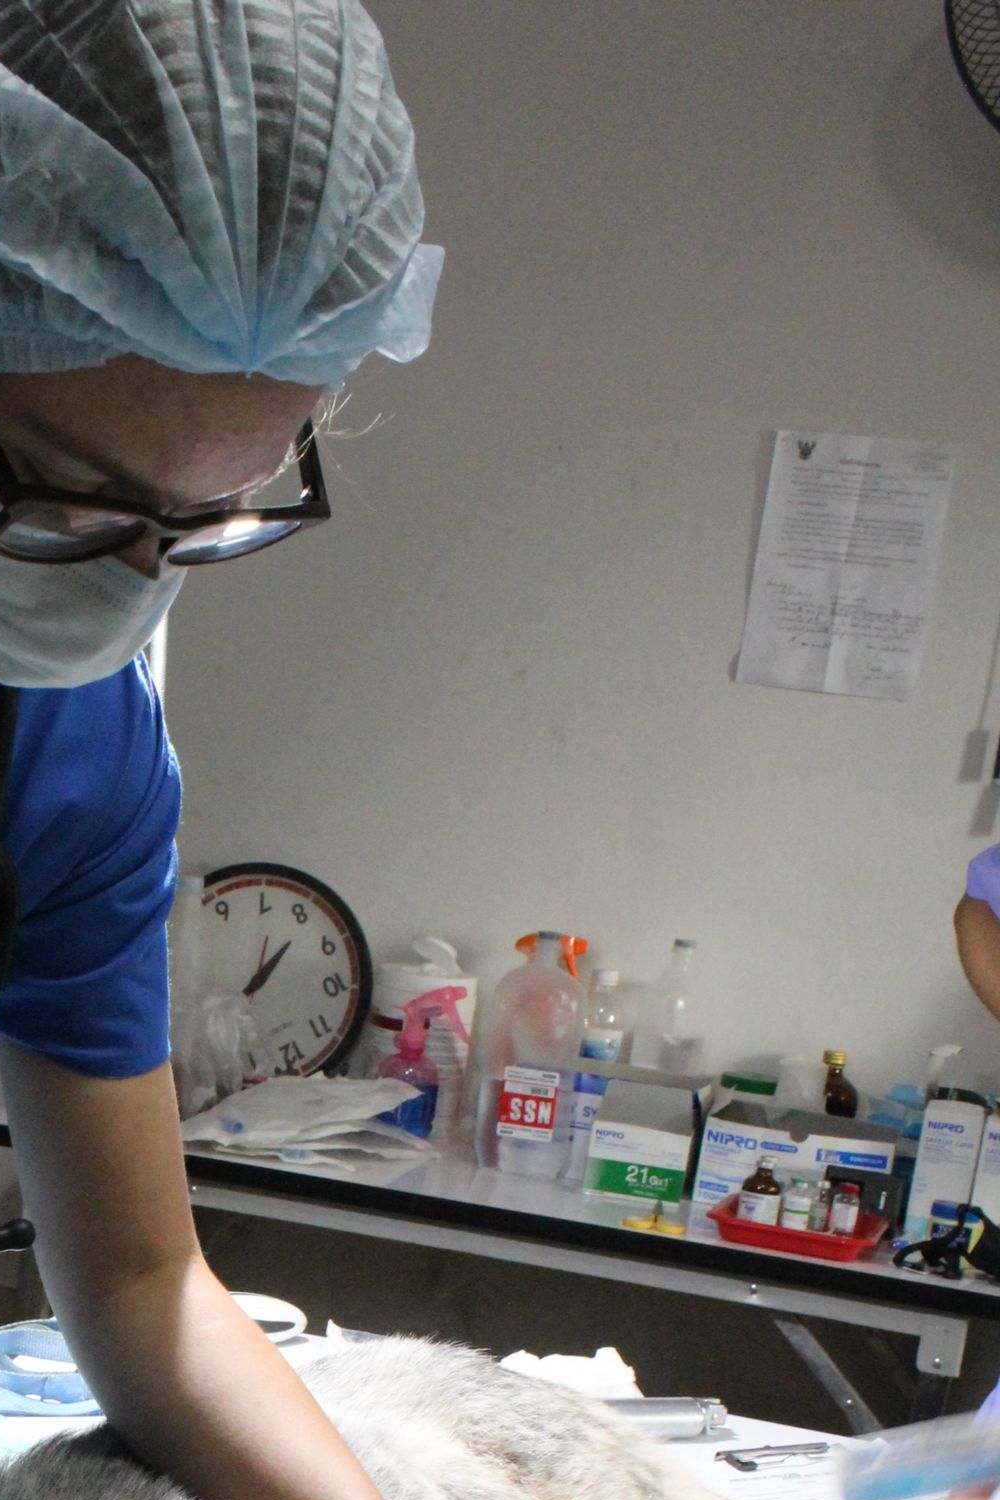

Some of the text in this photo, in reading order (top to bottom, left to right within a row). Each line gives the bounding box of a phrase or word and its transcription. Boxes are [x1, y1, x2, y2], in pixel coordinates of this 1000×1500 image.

[292, 904, 308, 924] 8
[323, 972, 349, 998] 10
[309, 1014, 332, 1038] 11
[279, 1040, 305, 1064] 12
[509, 1097, 552, 1124] SSN
[596, 1128, 624, 1140] NIPRO
[927, 1120, 965, 1135] NIPRO
[706, 1129, 758, 1150] NIPRO
